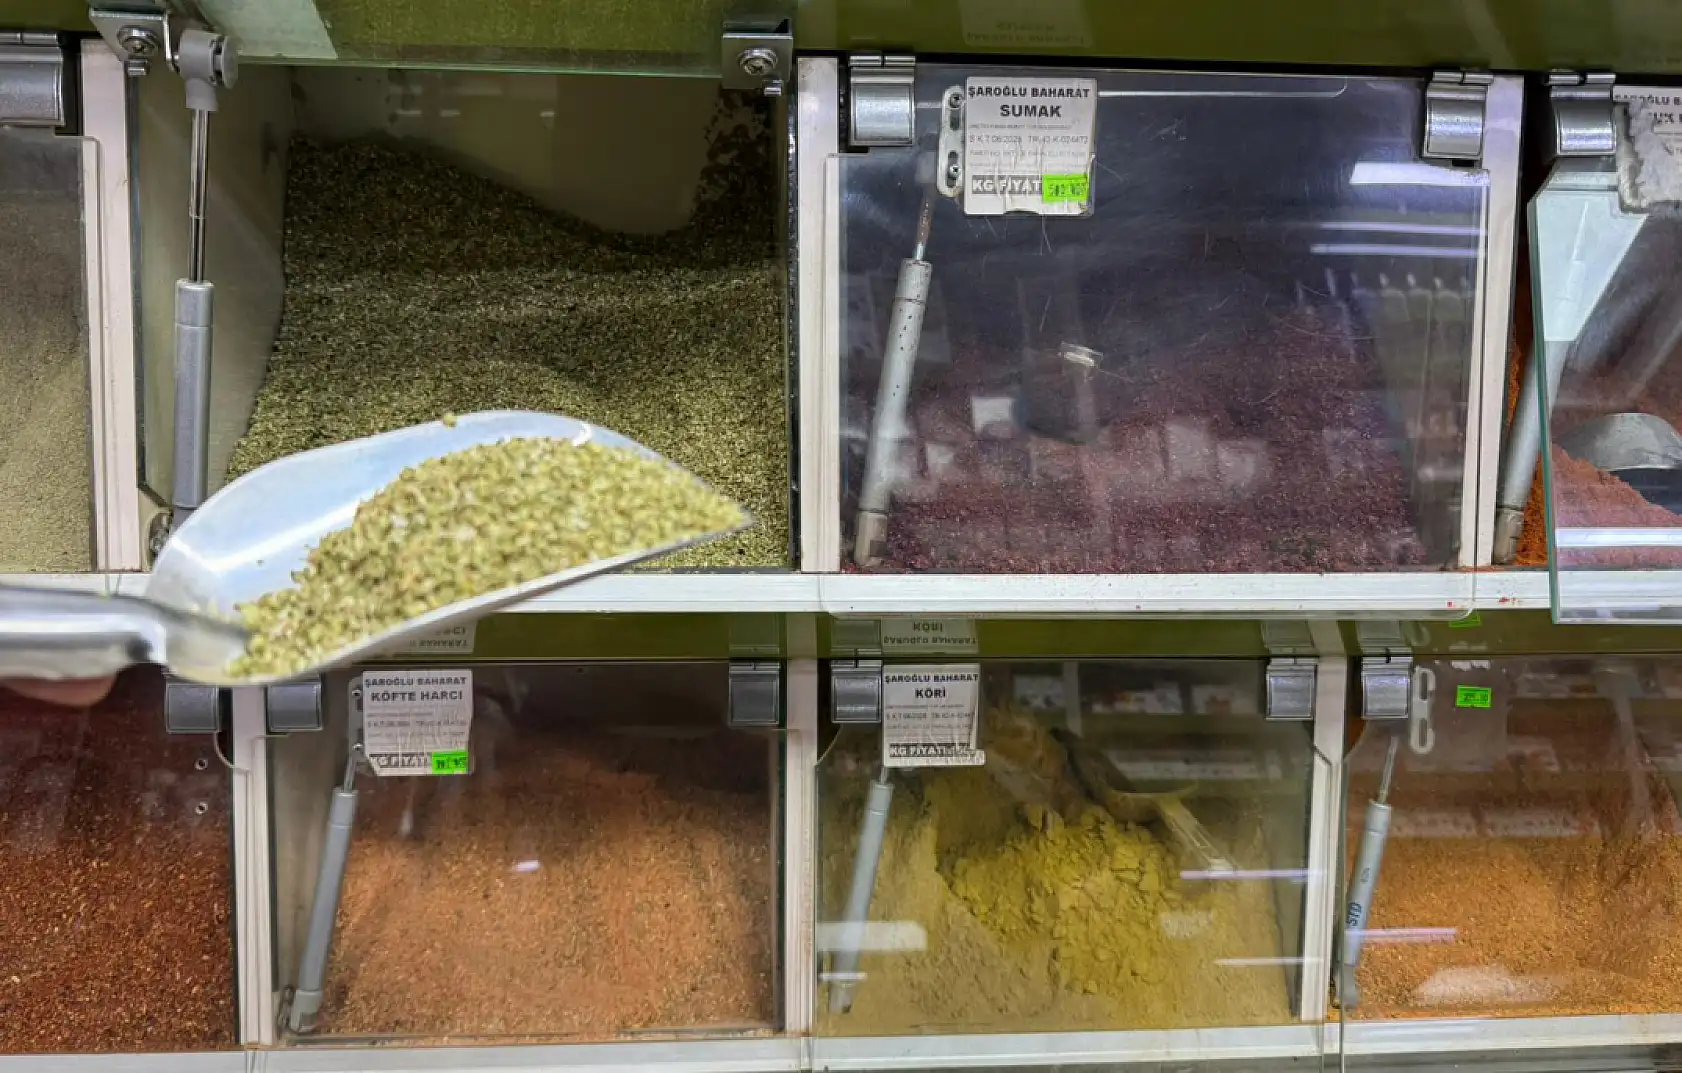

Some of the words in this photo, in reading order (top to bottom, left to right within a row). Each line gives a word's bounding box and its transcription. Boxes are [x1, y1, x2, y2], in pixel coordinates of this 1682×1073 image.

[968, 85, 1027, 99] ŞAROĞLU
[1030, 86, 1090, 98] BAHARAT
[1000, 104, 1062, 118] SUMAK
[972, 179, 994, 190] KG
[364, 676, 414, 688] ŞAROĞLU
[416, 677, 467, 686] BAHARAT
[884, 674, 931, 684] ŞAROĞLU
[933, 673, 979, 683] BAHARAT
[371, 690, 417, 702] KÖFTE
[421, 690, 463, 701] HARCI
[915, 687, 946, 699] KÖRİ
